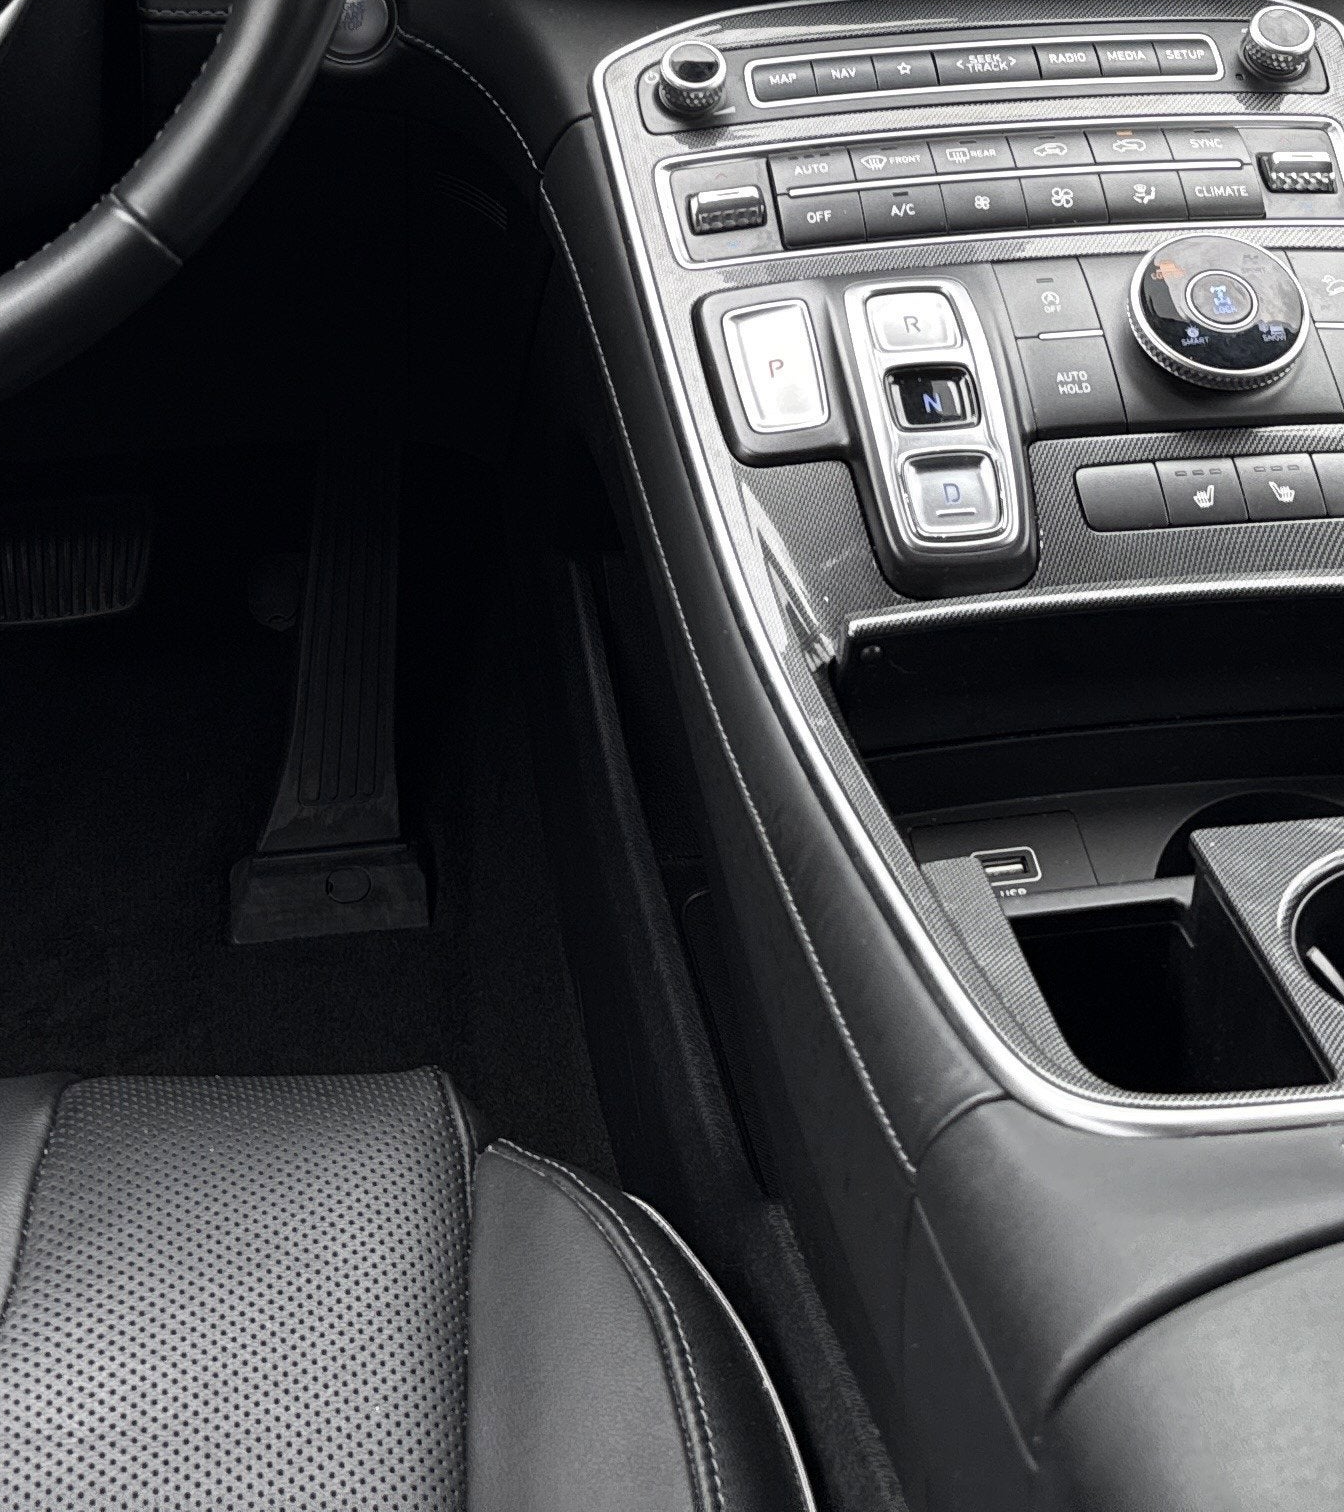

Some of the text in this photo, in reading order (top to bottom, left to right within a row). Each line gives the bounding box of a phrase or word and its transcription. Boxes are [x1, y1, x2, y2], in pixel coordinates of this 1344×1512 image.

[968, 54, 1003, 64] SEEK
[1048, 52, 1087, 64] RADIO
[1106, 50, 1147, 62] MEDIA
[1165, 49, 1205, 60] SETUP
[830, 67, 856, 80] NAV
[966, 62, 1008, 73] TRACK
[769, 73, 797, 85] MAP
[1189, 138, 1222, 149] SYNC
[970, 148, 996, 158] REAR
[888, 154, 921, 165] FRONT
[794, 163, 829, 176] AUTO
[1194, 185, 1249, 198] CLIMATE
[806, 209, 832, 224] OFF
[890, 203, 916, 218] A/C
[1043, 304, 1063, 314] OFF
[903, 315, 922, 334] R
[1181, 336, 1210, 346] SMART
[768, 359, 784, 378] P
[1056, 371, 1089, 383] AUTO
[1058, 382, 1092, 395] HOLD
[921, 393, 943, 414] N
[942, 483, 963, 504] D
